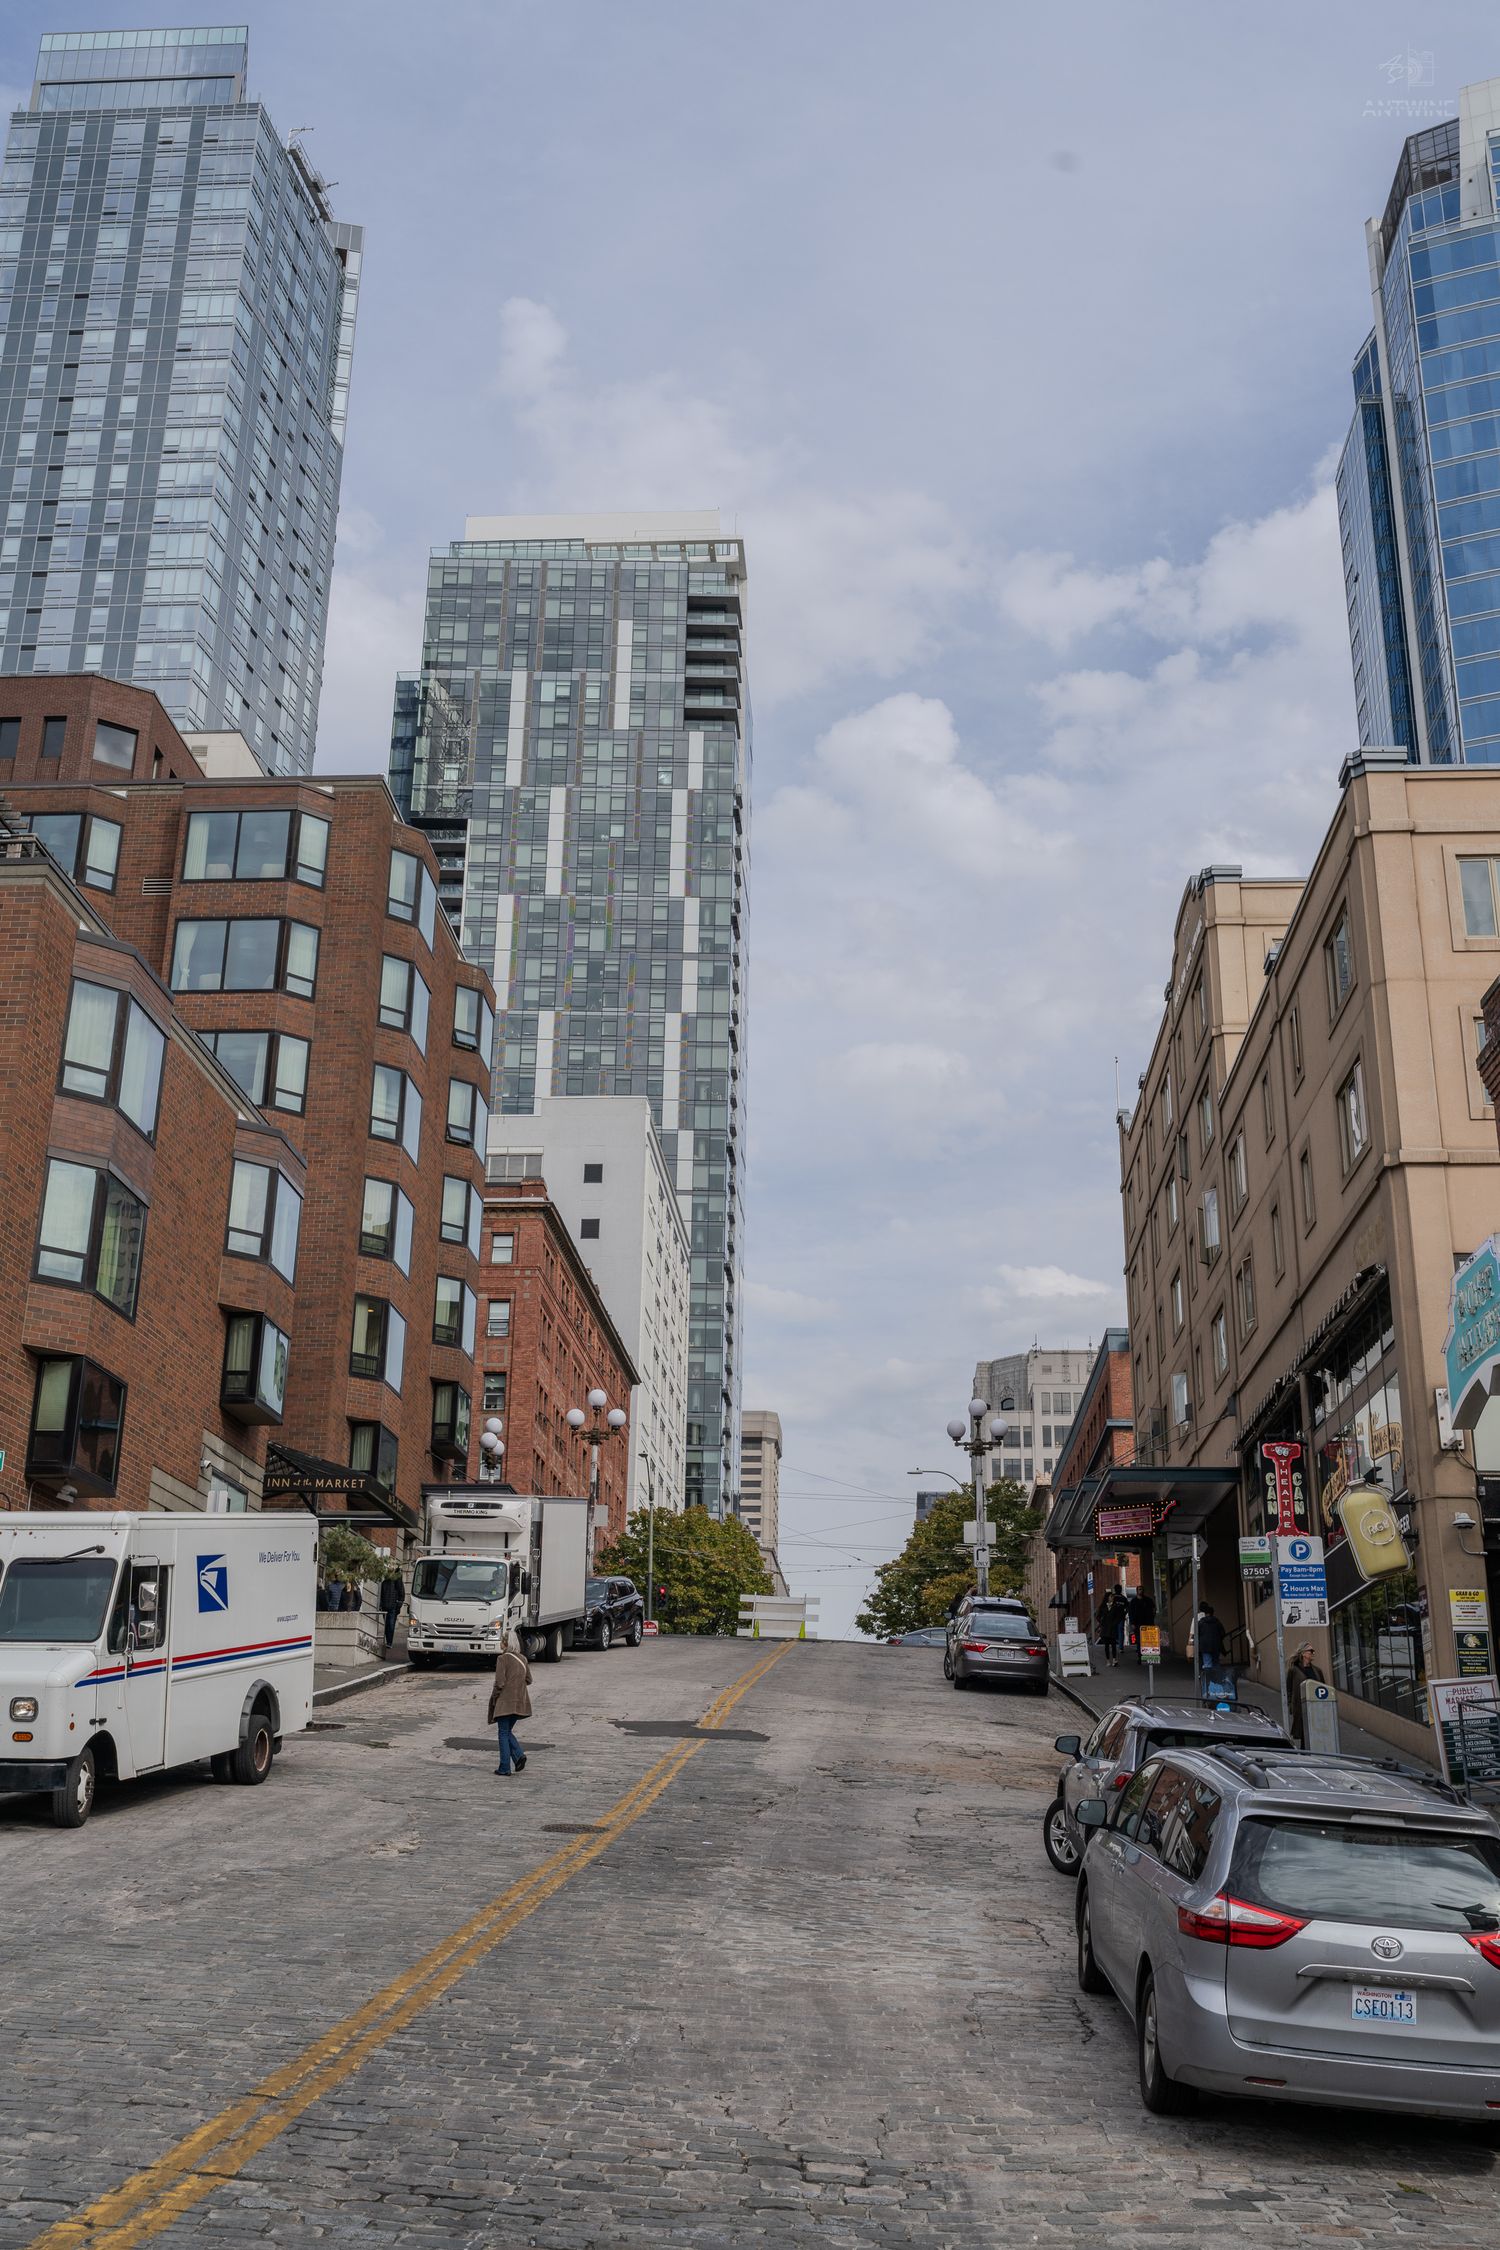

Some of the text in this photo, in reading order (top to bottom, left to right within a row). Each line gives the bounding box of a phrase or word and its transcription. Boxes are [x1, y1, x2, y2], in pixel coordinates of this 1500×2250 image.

[267, 1478, 290, 1487] INN
[315, 1479, 366, 1489] MARKET
[1265, 1472, 1277, 1515] CAN
[1280, 1460, 1291, 1528] THEATRE
[1292, 1472, 1305, 1515] CAN
[259, 1552, 267, 1563] We
[267, 1551, 283, 1563] Deliver
[283, 1551, 291, 1562] For
[1243, 1567, 1270, 1576] 87505
[1282, 1583, 1289, 1592] 2
[1452, 1686, 1479, 1696] PUBLIC
[1357, 1991, 1392, 1999] WASHINGTON
[1355, 1998, 1413, 2019] CSE0113
